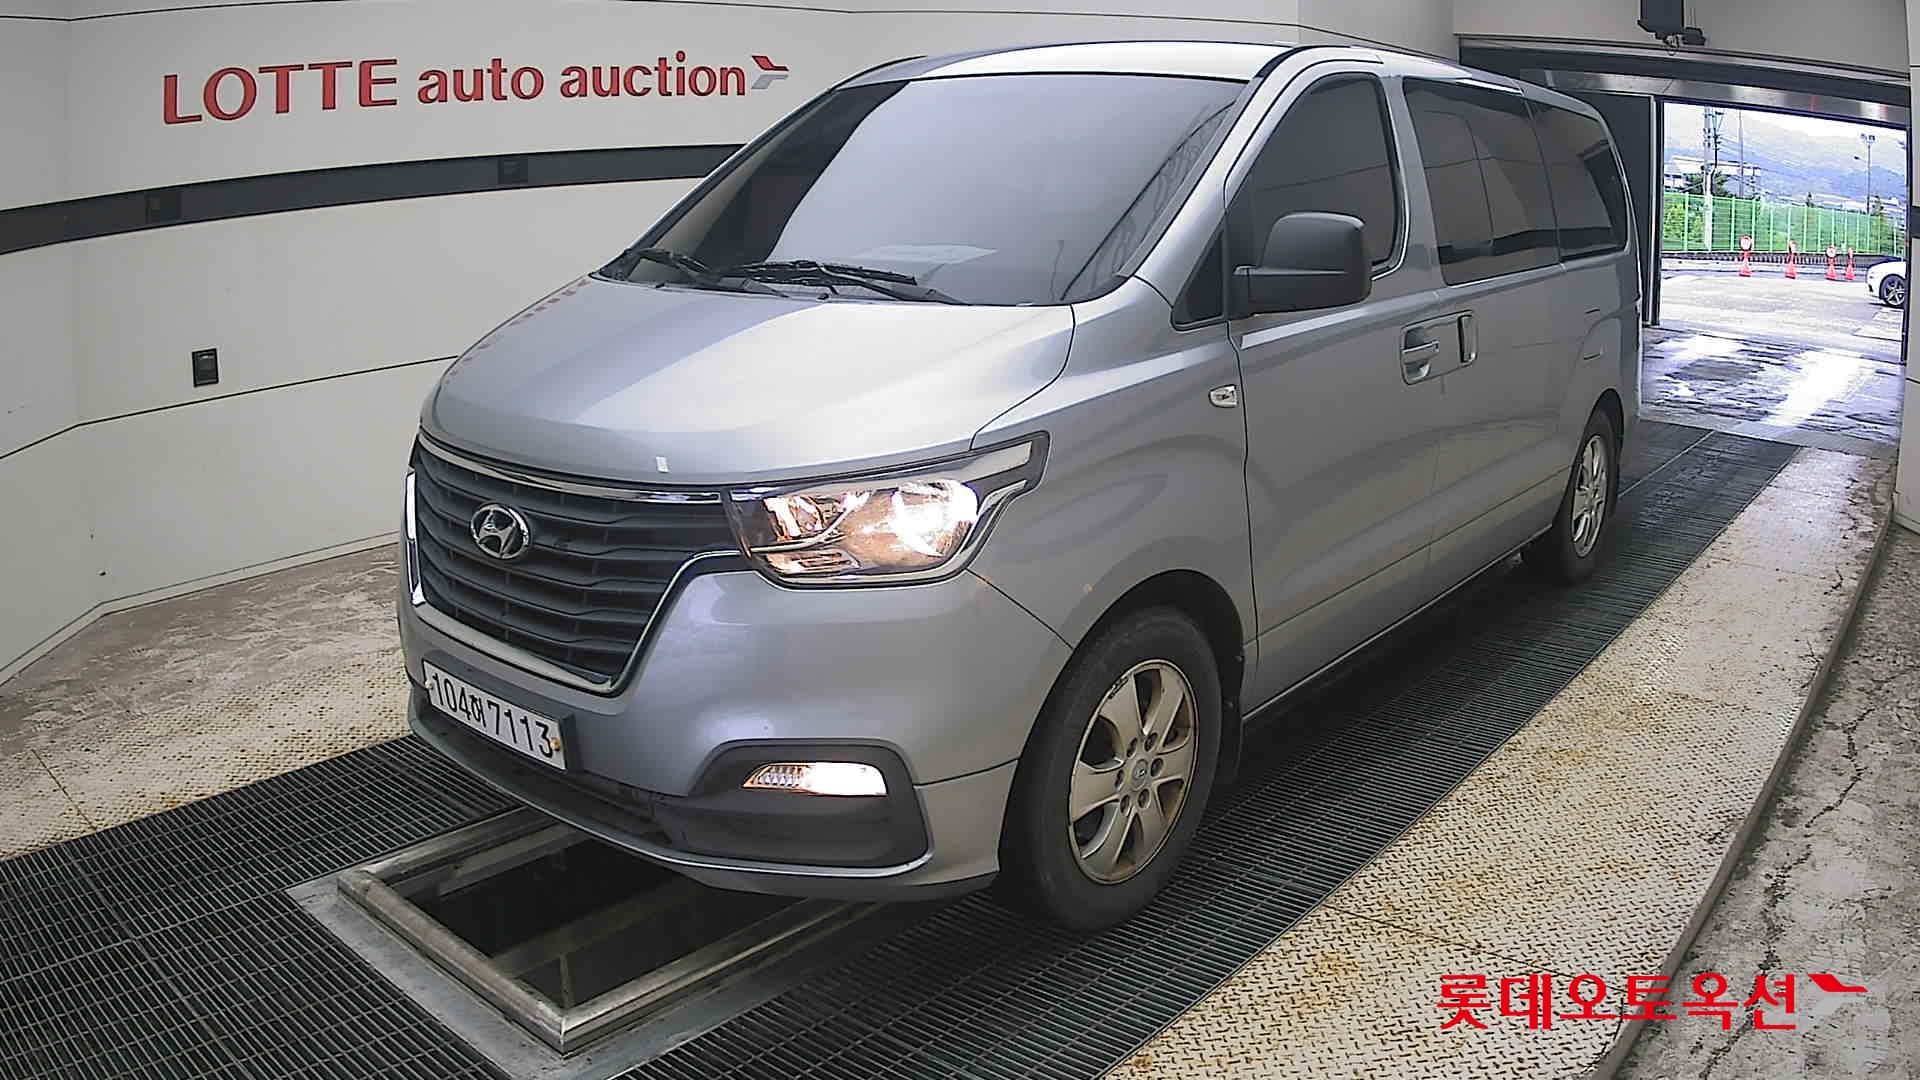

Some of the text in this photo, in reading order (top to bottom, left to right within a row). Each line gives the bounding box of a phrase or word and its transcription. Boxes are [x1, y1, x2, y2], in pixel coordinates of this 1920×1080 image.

[163, 50, 747, 125] LOTTE auto auction
